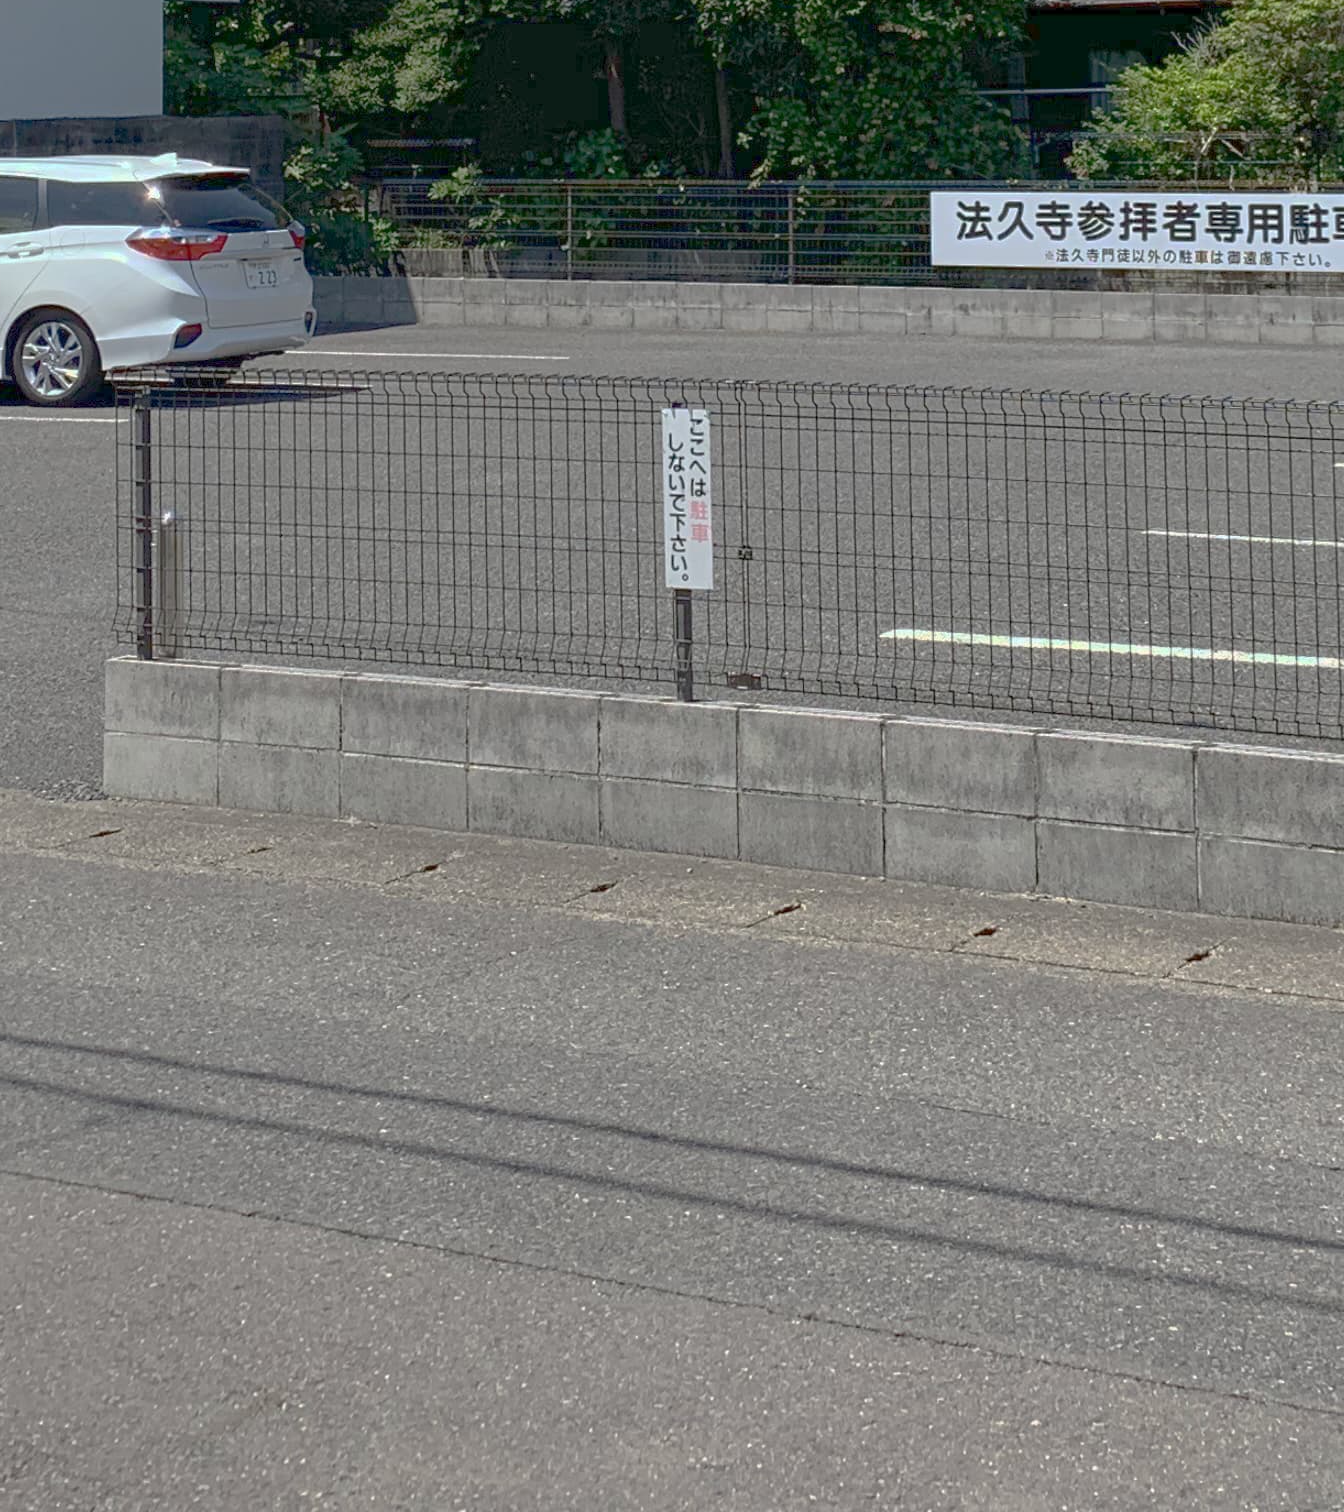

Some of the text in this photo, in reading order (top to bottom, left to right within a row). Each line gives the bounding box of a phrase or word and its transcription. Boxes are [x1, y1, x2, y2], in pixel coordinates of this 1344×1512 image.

[669, 433, 689, 581] しないで下さい。
